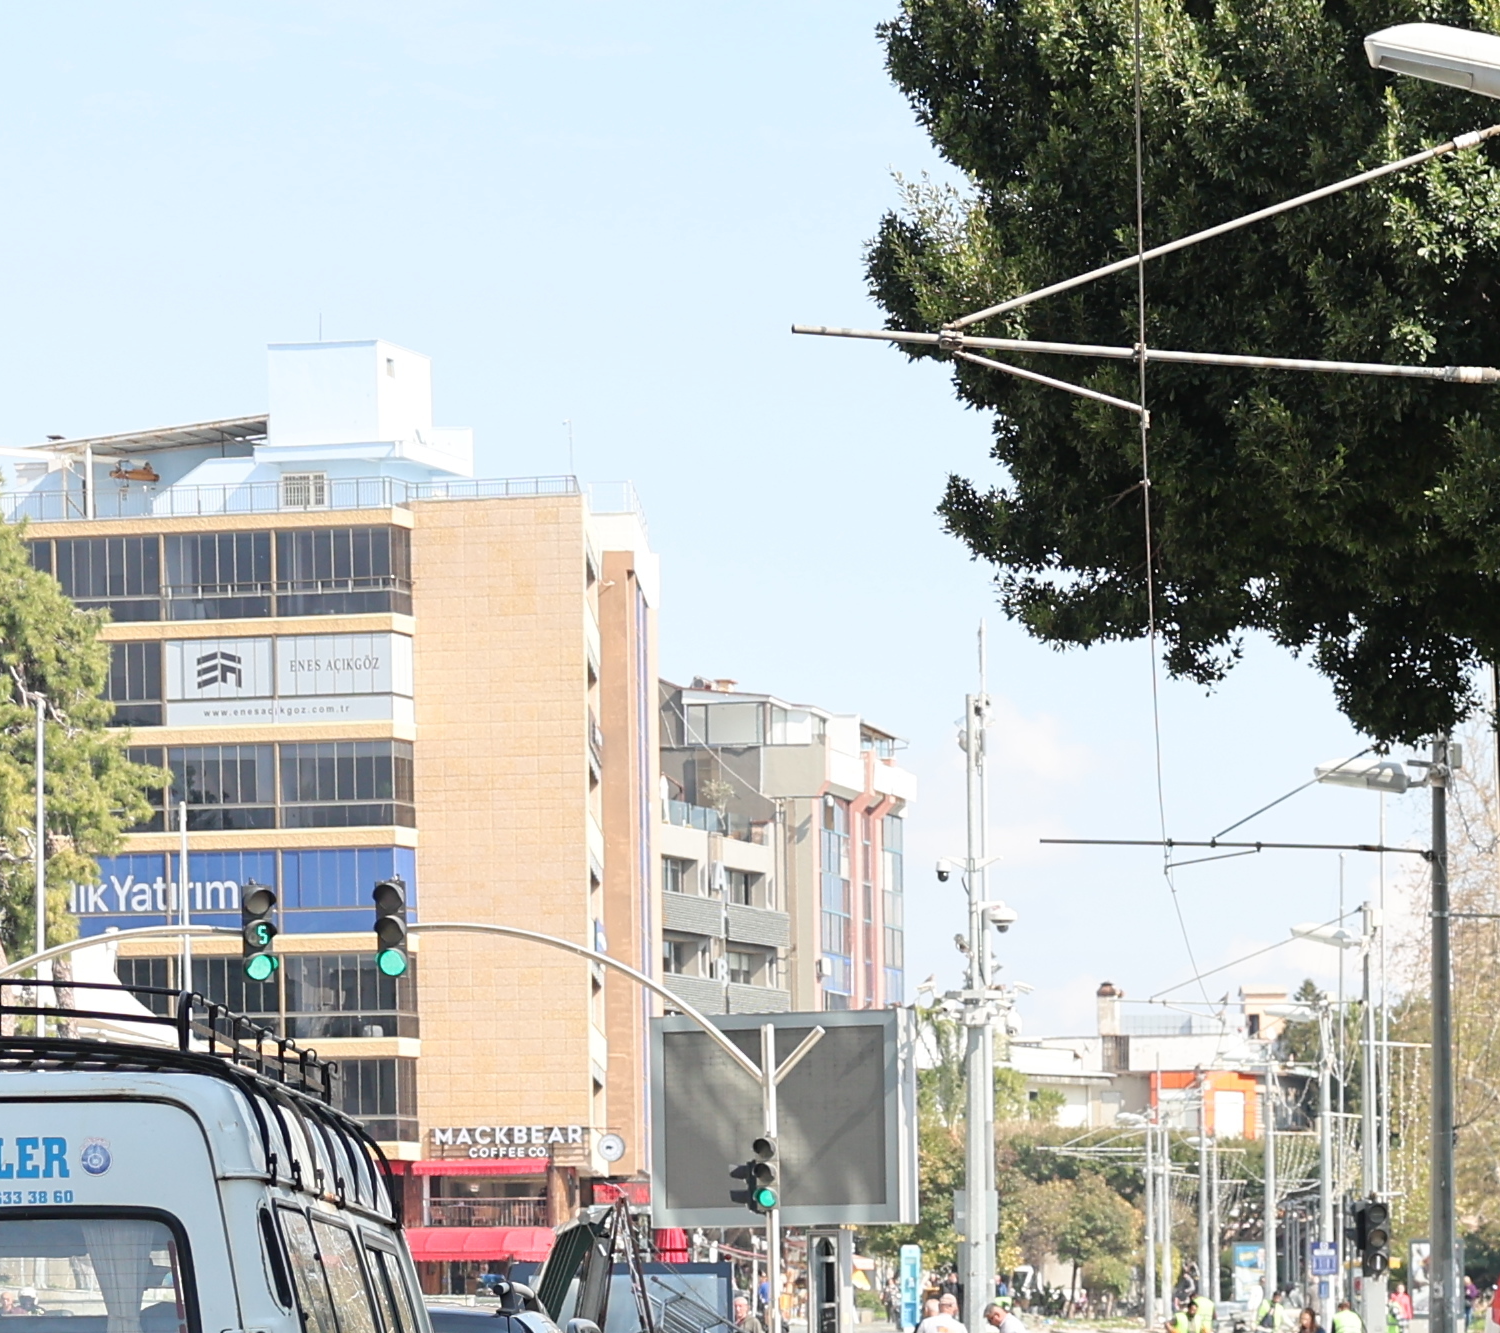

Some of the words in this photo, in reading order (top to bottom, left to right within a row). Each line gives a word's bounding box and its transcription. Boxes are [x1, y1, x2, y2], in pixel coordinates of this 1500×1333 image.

[290, 659, 321, 672] ENES
[326, 655, 380, 674] AÇIKGÖZ
[435, 1125, 582, 1146] MACKBEAR
[468, 1146, 525, 1158] COFFEE
[528, 1146, 549, 1158] CO.
[28, 1191, 48, 1205] 38
[53, 1190, 75, 1205] 60
